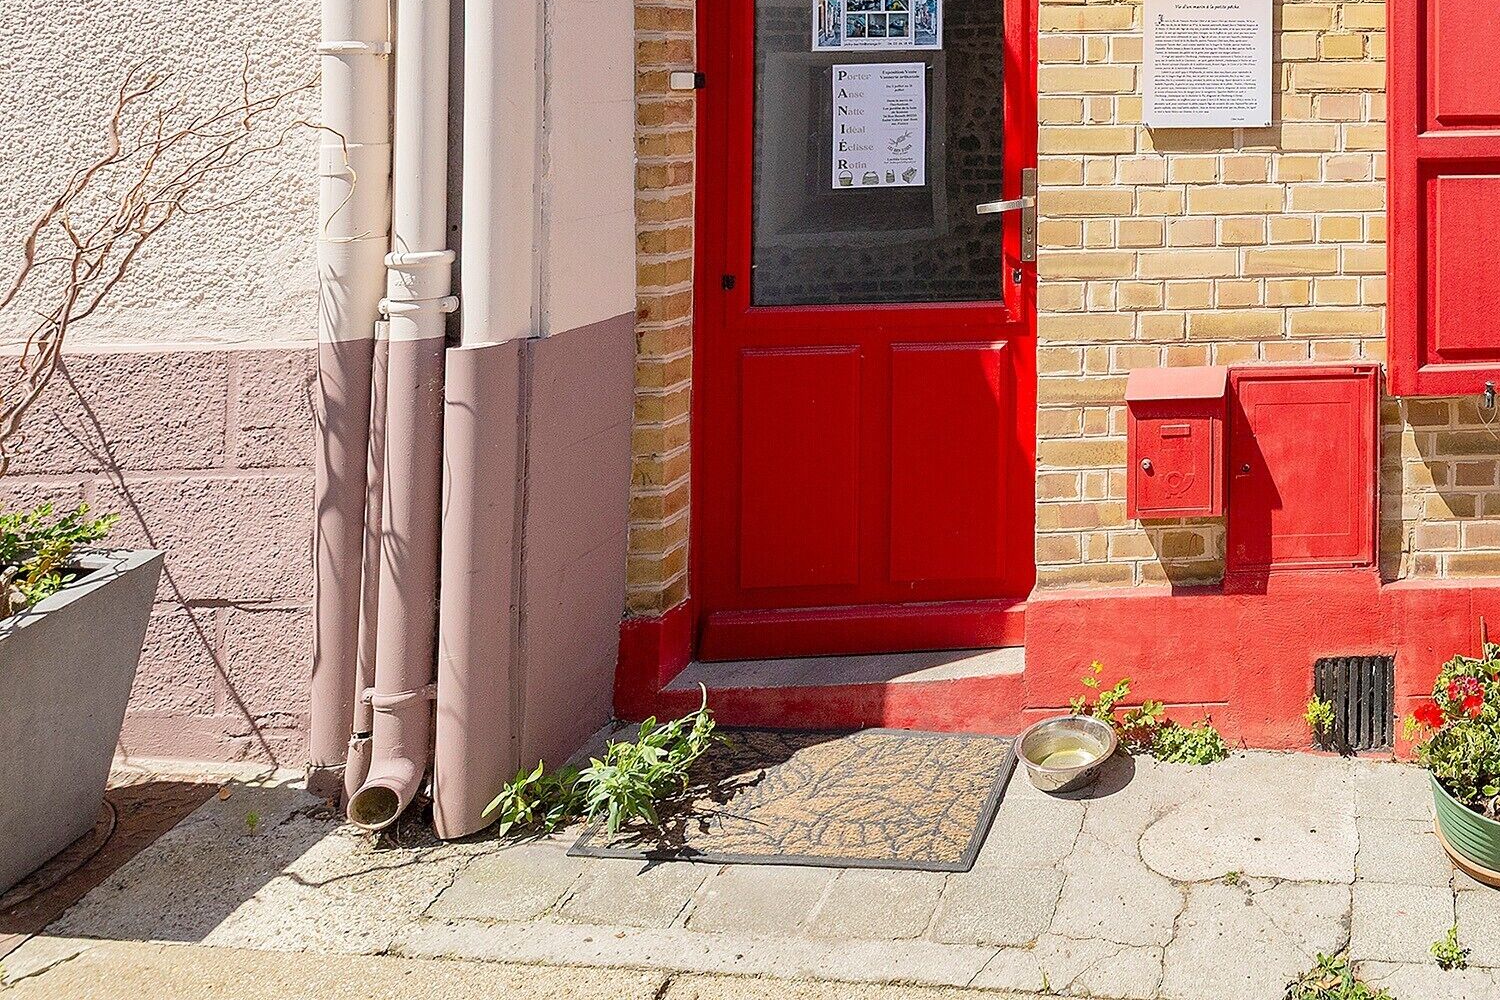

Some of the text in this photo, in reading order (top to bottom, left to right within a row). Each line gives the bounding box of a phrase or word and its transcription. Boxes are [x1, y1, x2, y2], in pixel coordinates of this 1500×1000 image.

[838, 70, 871, 81] Porter
[837, 88, 865, 99] Anse
[837, 159, 867, 170] Rotin
